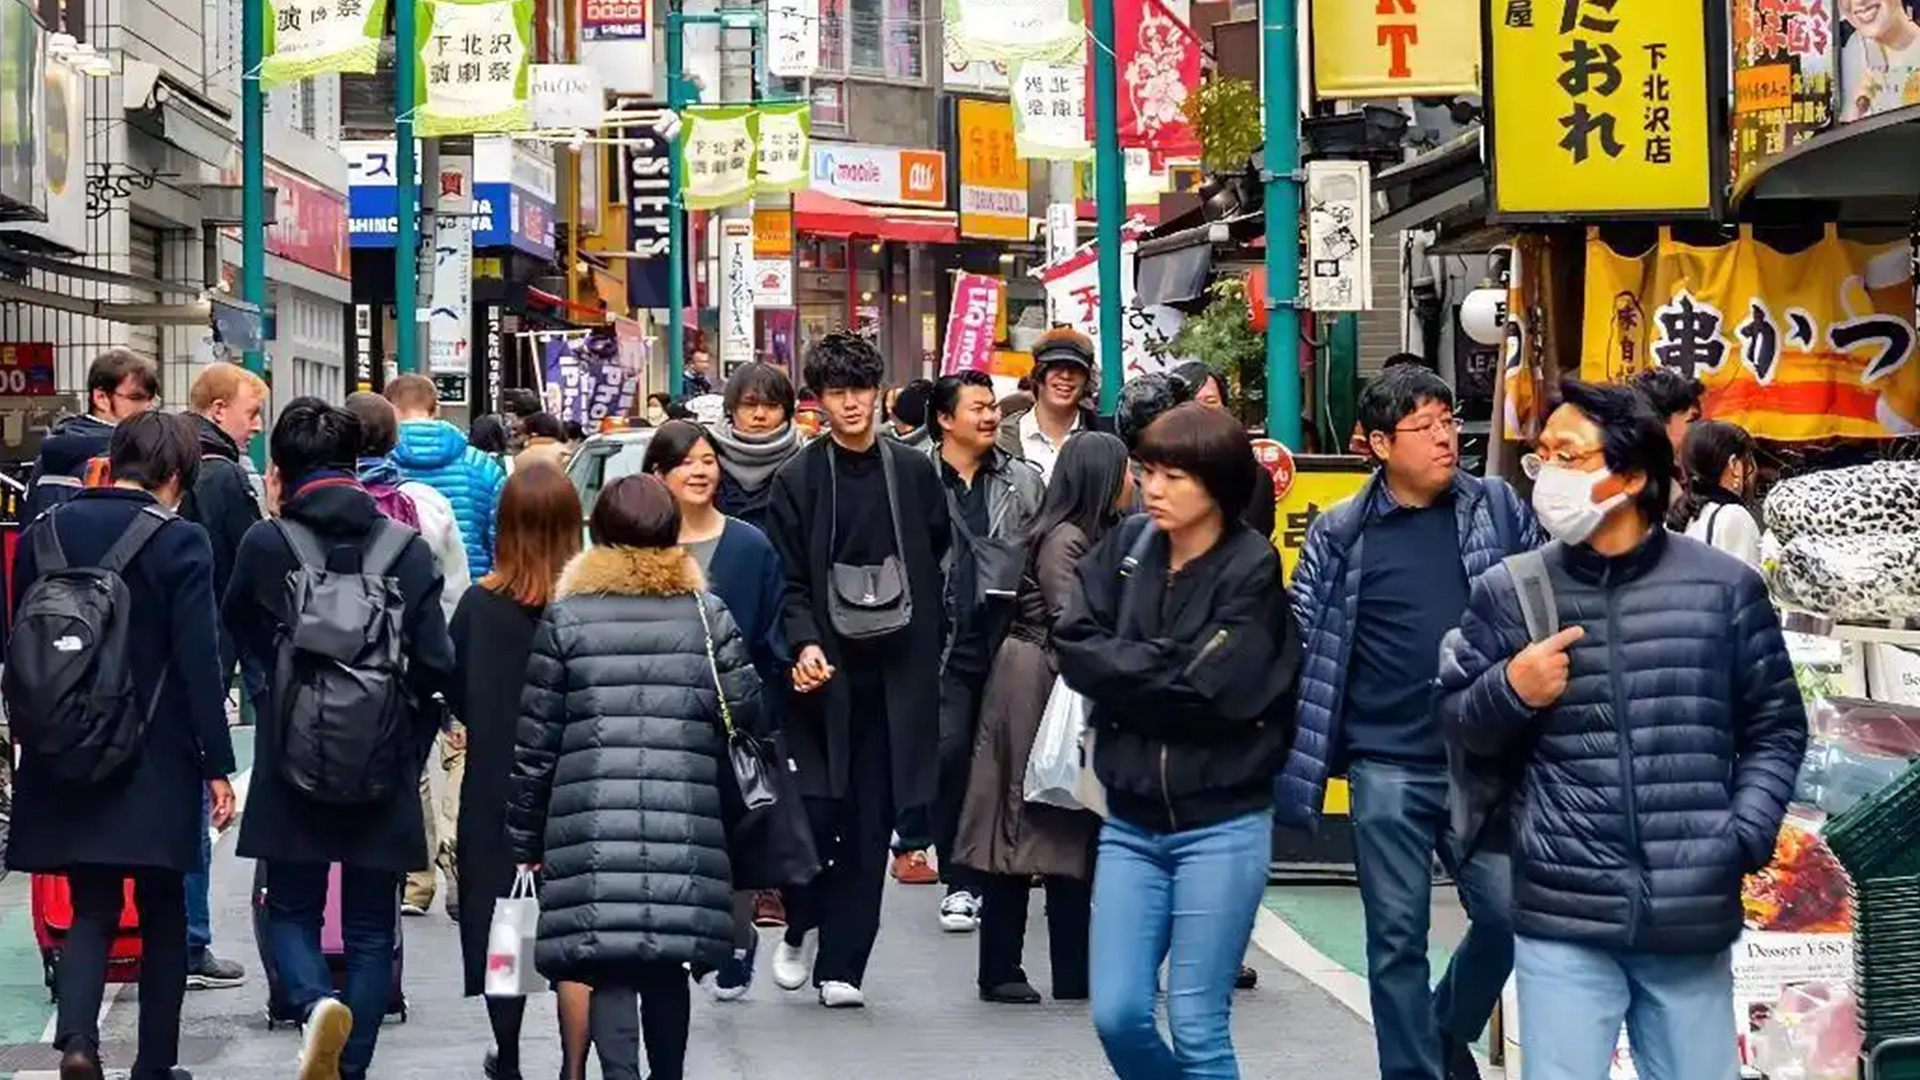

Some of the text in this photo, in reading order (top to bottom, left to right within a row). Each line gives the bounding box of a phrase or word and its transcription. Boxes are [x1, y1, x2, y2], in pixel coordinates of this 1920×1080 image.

[432, 33, 512, 56] 下北沢
[1375, 0, 1418, 78] T
[430, 61, 511, 84] 演劇祭
[1642, 42, 1673, 164] 下北沢店
[837, 161, 881, 183] mobile
[909, 163, 935, 191] au
[1654, 293, 1913, 384] 串かつ
